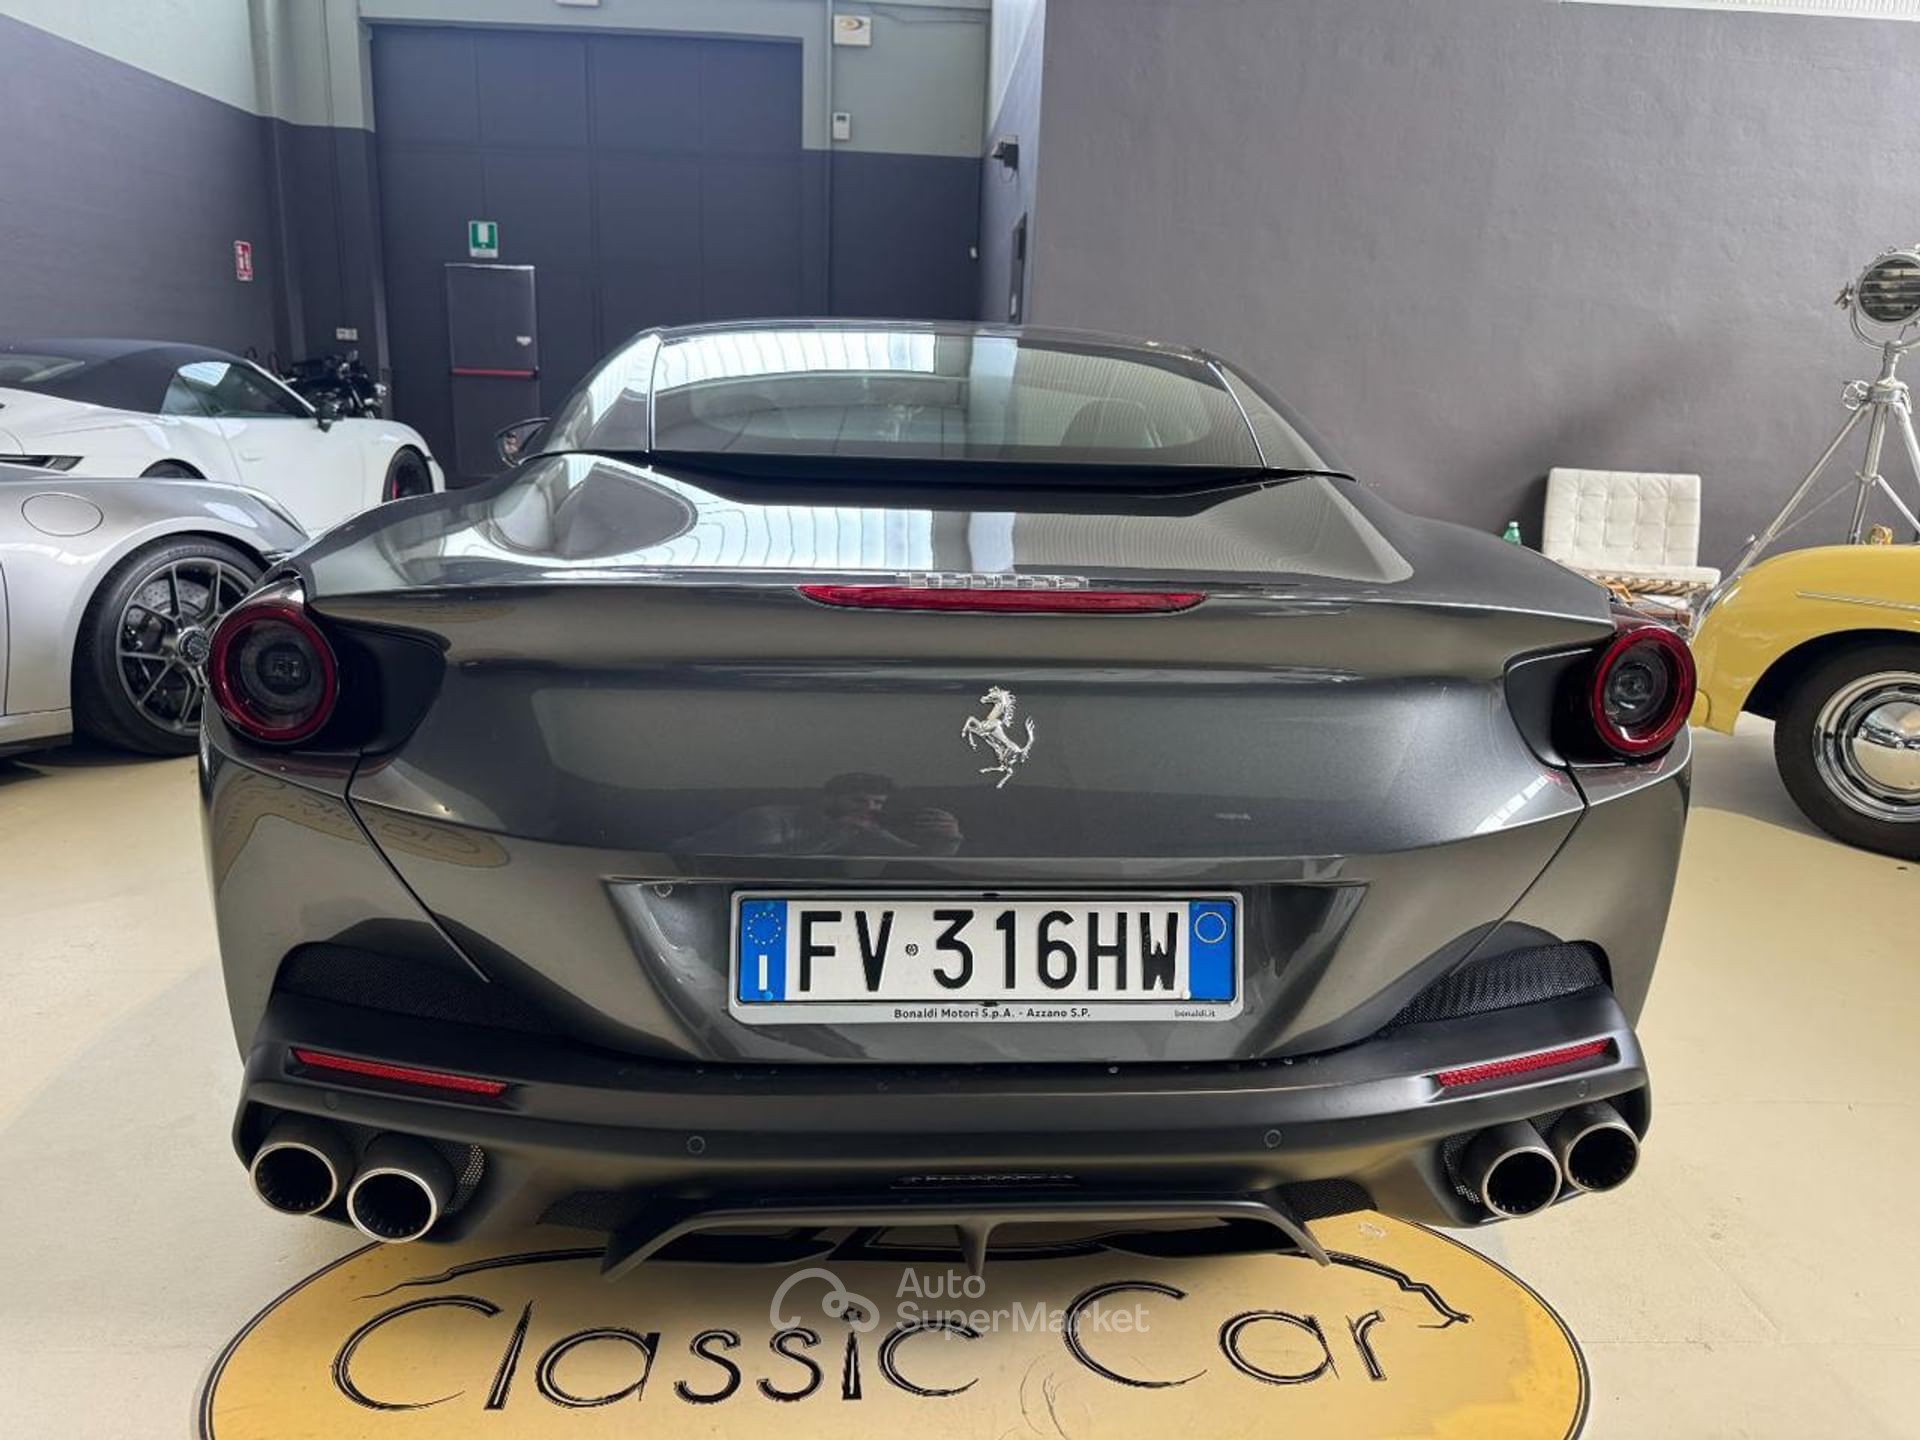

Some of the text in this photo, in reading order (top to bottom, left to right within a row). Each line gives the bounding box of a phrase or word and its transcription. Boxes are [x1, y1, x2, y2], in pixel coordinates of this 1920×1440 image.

[758, 954, 768, 991] I
[799, 909, 1179, 992] FV 316HW
[893, 1007, 938, 1019] Bonaldi
[941, 1007, 979, 1018] Motori
[981, 1007, 1016, 1020] S.p.A.
[1026, 1007, 1068, 1018] Azzano
[1070, 1007, 1091, 1018] S.P.
[331, 1280, 1388, 1410] Classic Car
